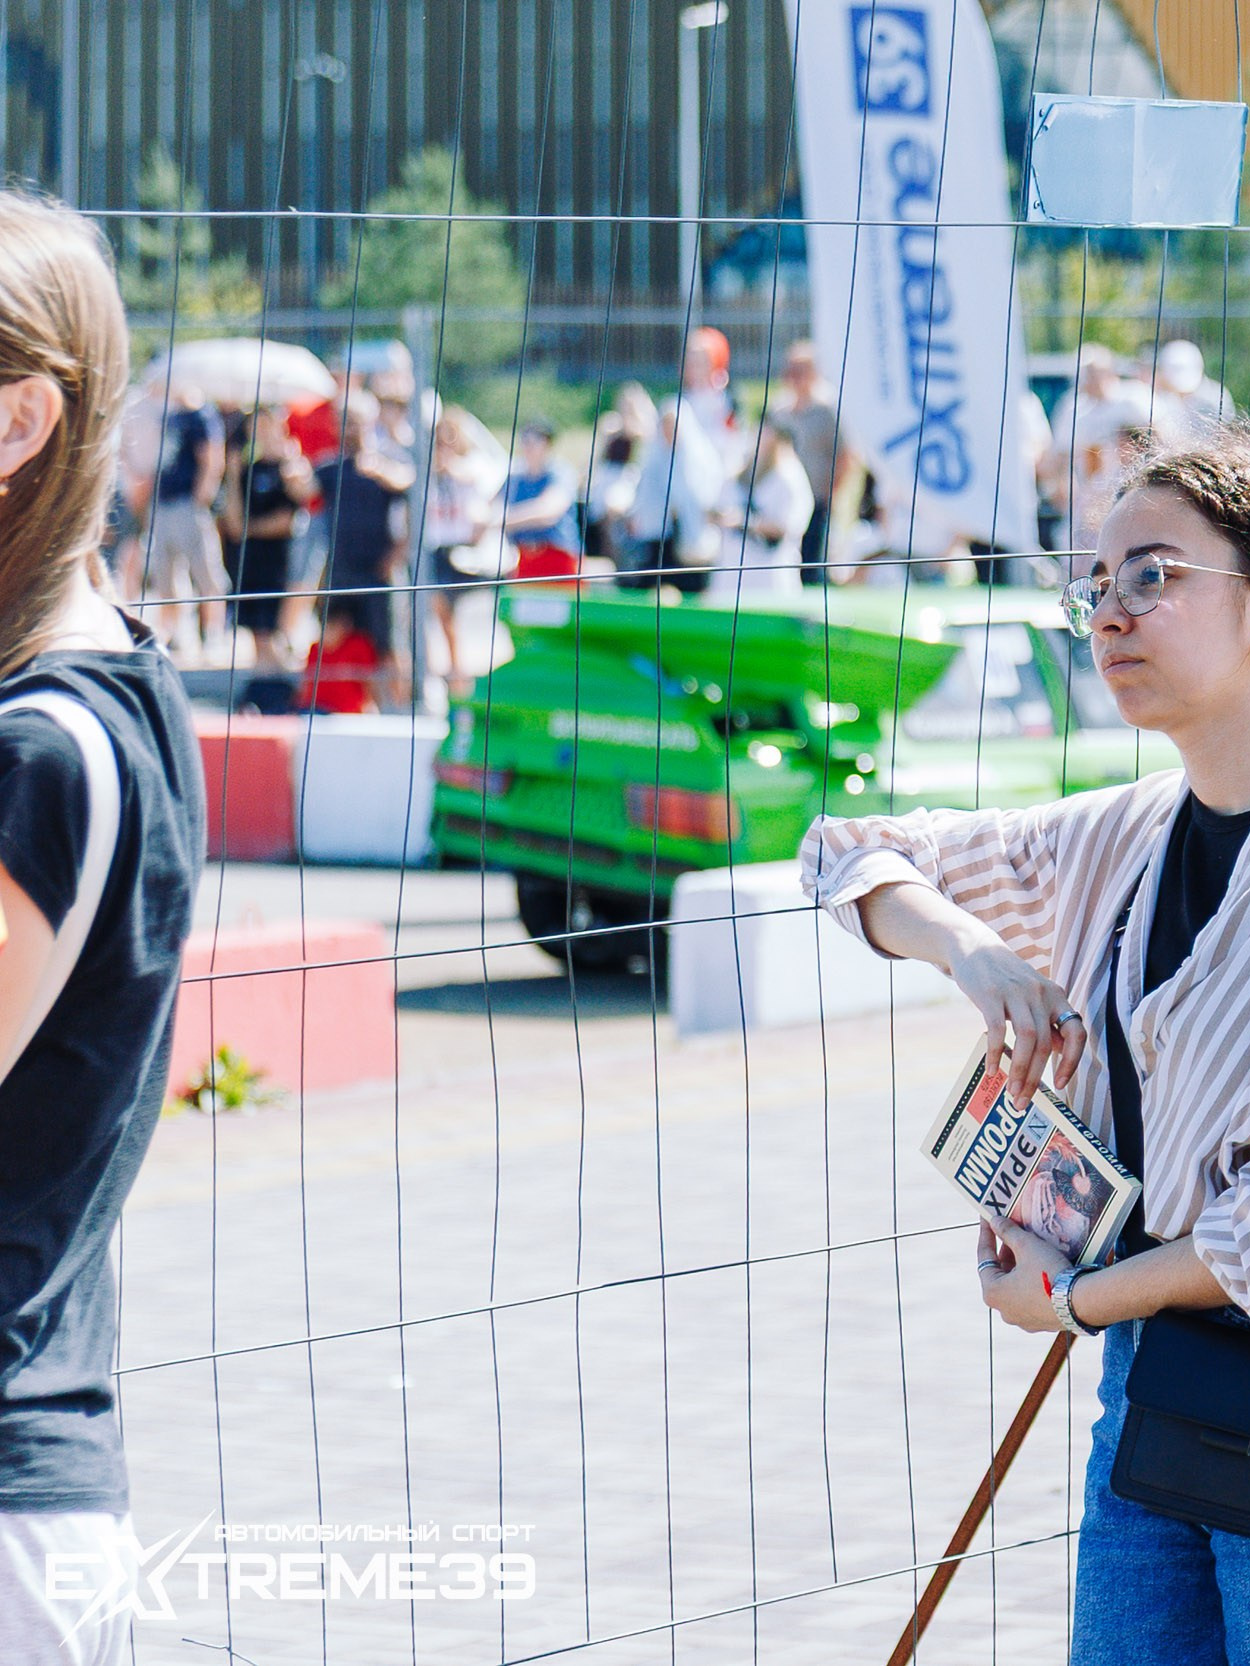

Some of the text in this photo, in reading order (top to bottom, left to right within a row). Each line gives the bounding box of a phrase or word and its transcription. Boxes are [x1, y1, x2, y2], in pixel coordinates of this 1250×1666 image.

[858, 11, 971, 494] extreme 39
[984, 1135, 1037, 1217] ЭРИХ
[1058, 1103, 1128, 1175] ЭРИХ ФРОММ
